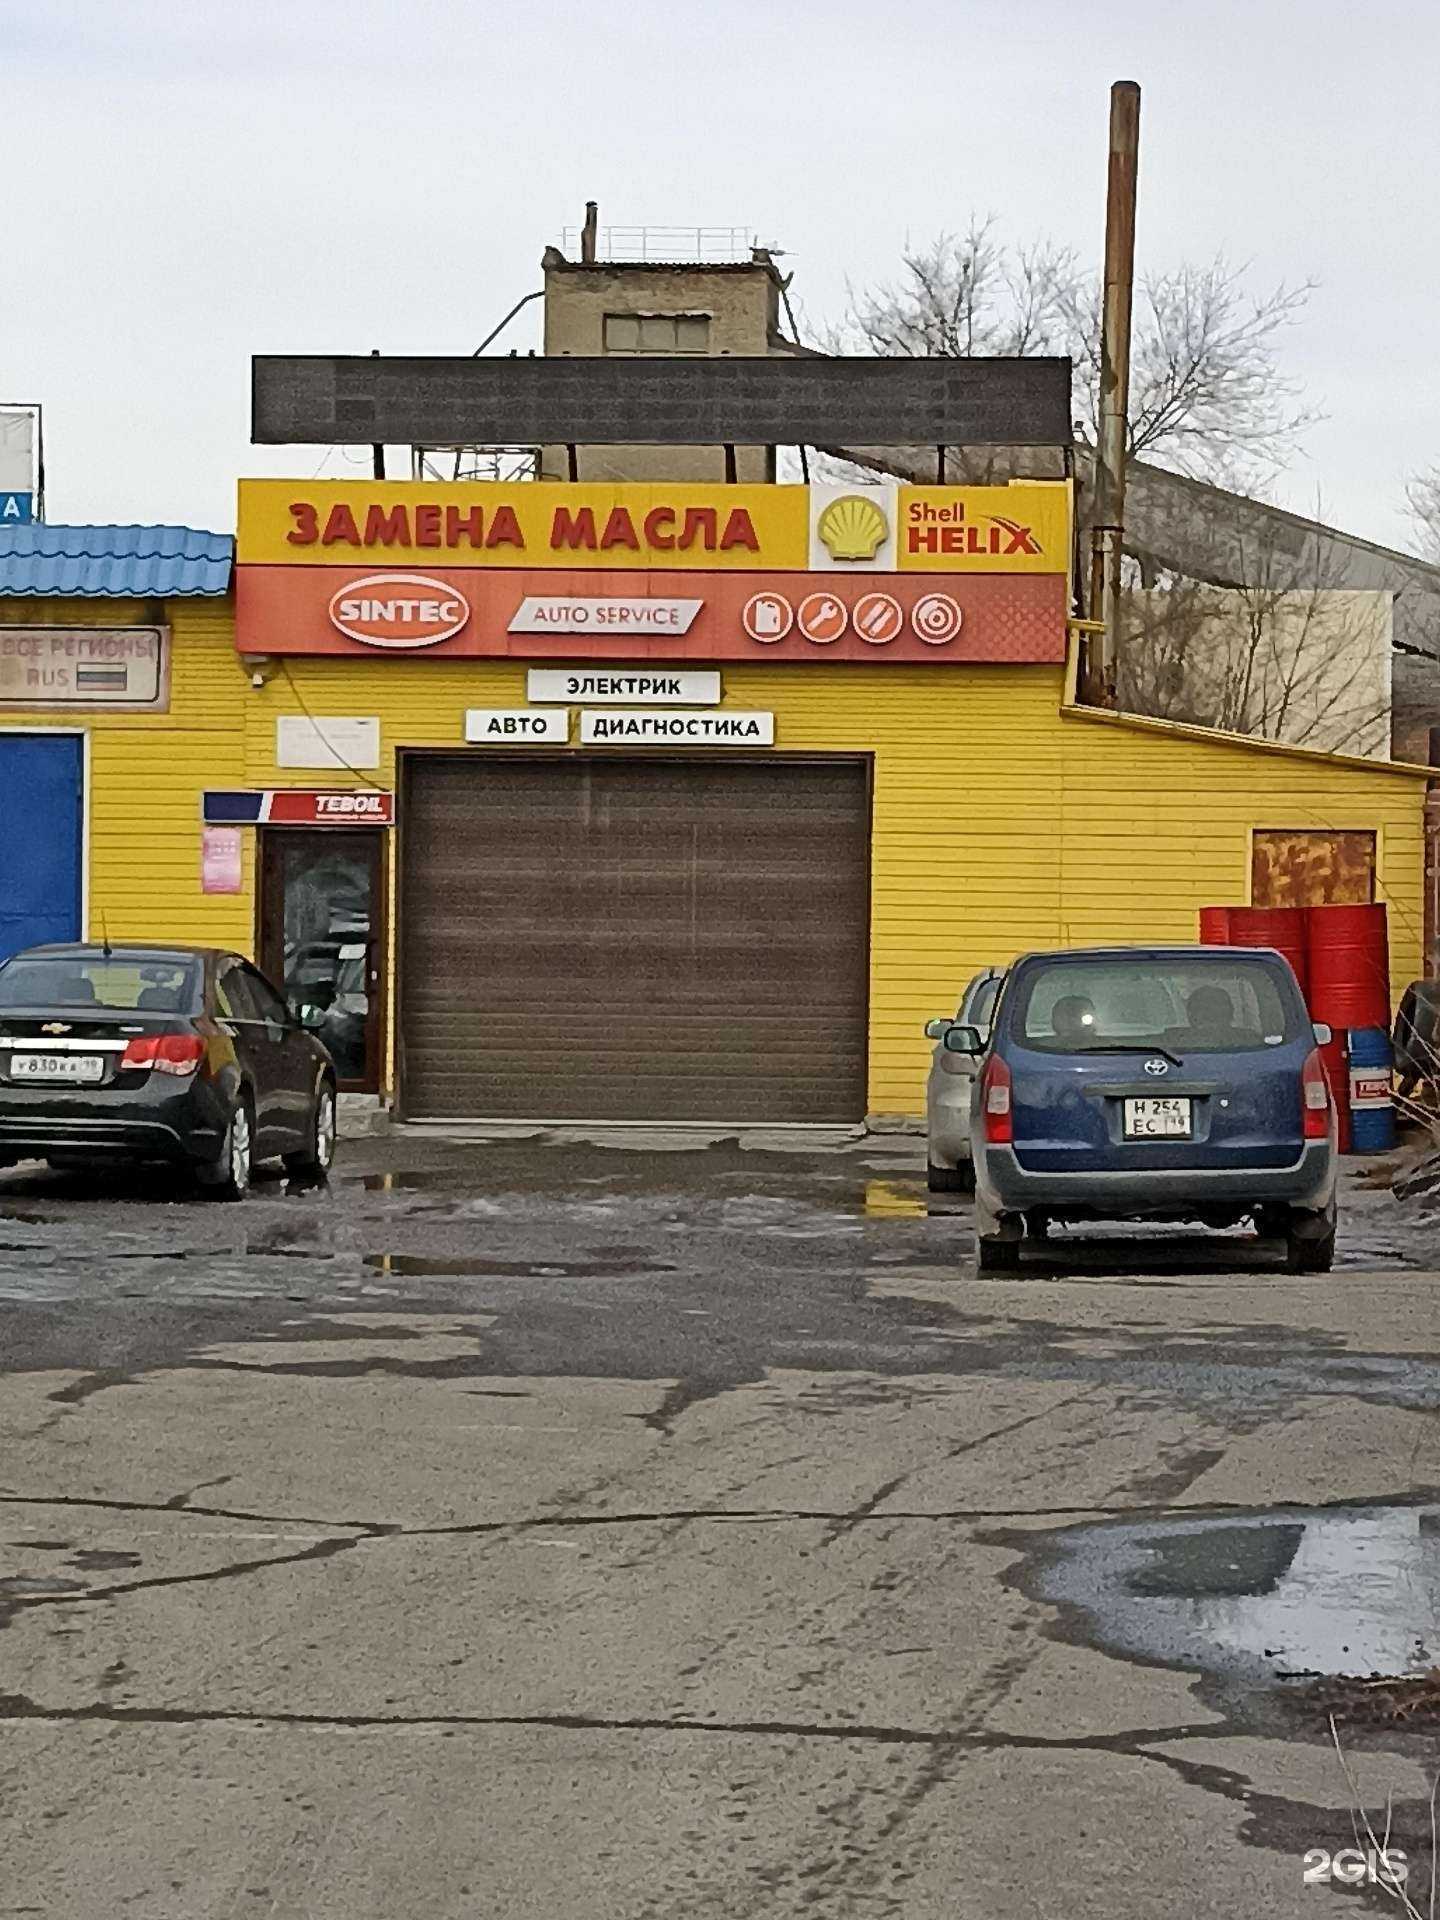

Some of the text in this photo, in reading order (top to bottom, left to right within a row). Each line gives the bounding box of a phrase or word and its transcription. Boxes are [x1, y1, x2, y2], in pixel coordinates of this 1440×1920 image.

[909, 502, 965, 522] Shell
[287, 503, 760, 551] ЗАМЕНА МАСЛА
[908, 525, 1042, 555] HELIX
[340, 600, 459, 622] SINTEC
[533, 606, 679, 625] AUTO SERVICE
[27, 668, 70, 686] RUS
[567, 677, 681, 695] ЭЛЕКТРИК
[487, 717, 548, 735] АВТО
[593, 718, 760, 738] ДИАГНОСТИКА
[315, 796, 383, 813] TEBOIL
